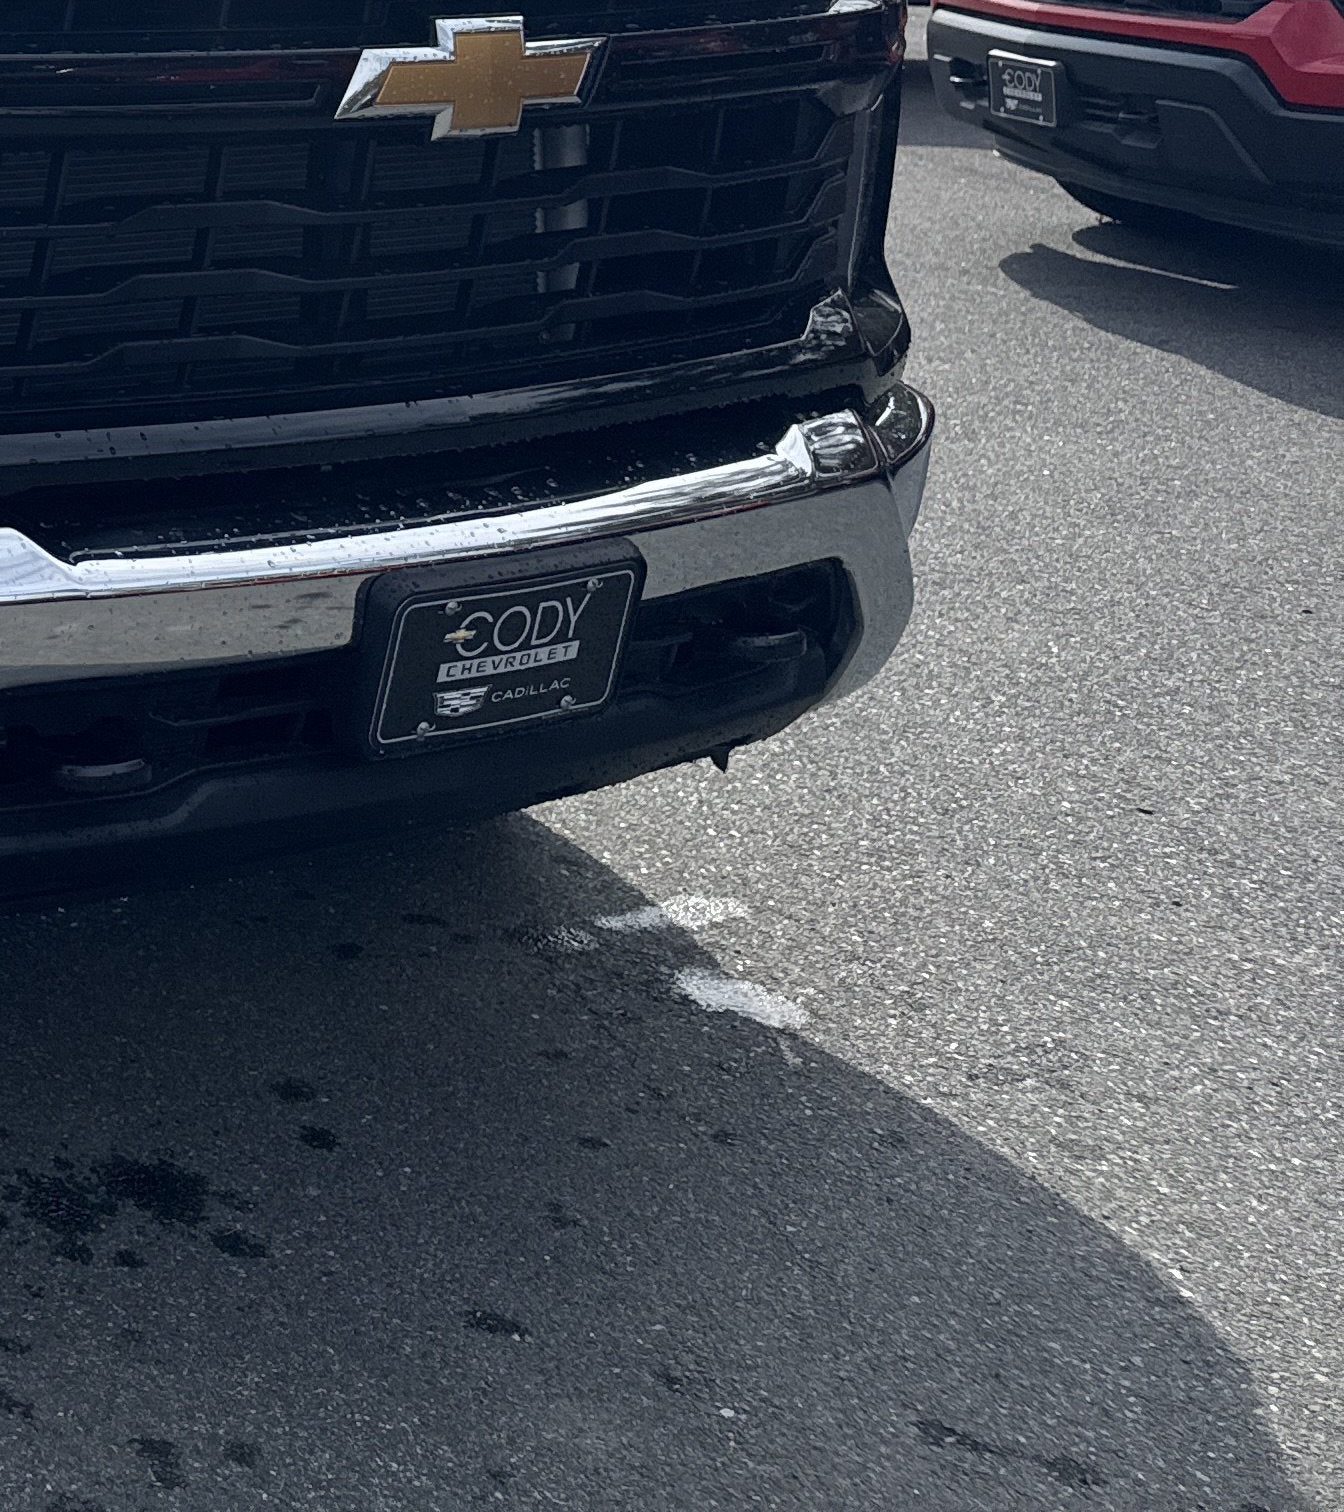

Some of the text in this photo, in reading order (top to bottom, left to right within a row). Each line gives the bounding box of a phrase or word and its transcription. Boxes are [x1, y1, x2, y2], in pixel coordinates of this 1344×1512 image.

[1004, 68, 1041, 92] CODY
[454, 592, 591, 657] CODY
[446, 645, 573, 678] CHEVROLET
[491, 678, 571, 703] CADILLAC
